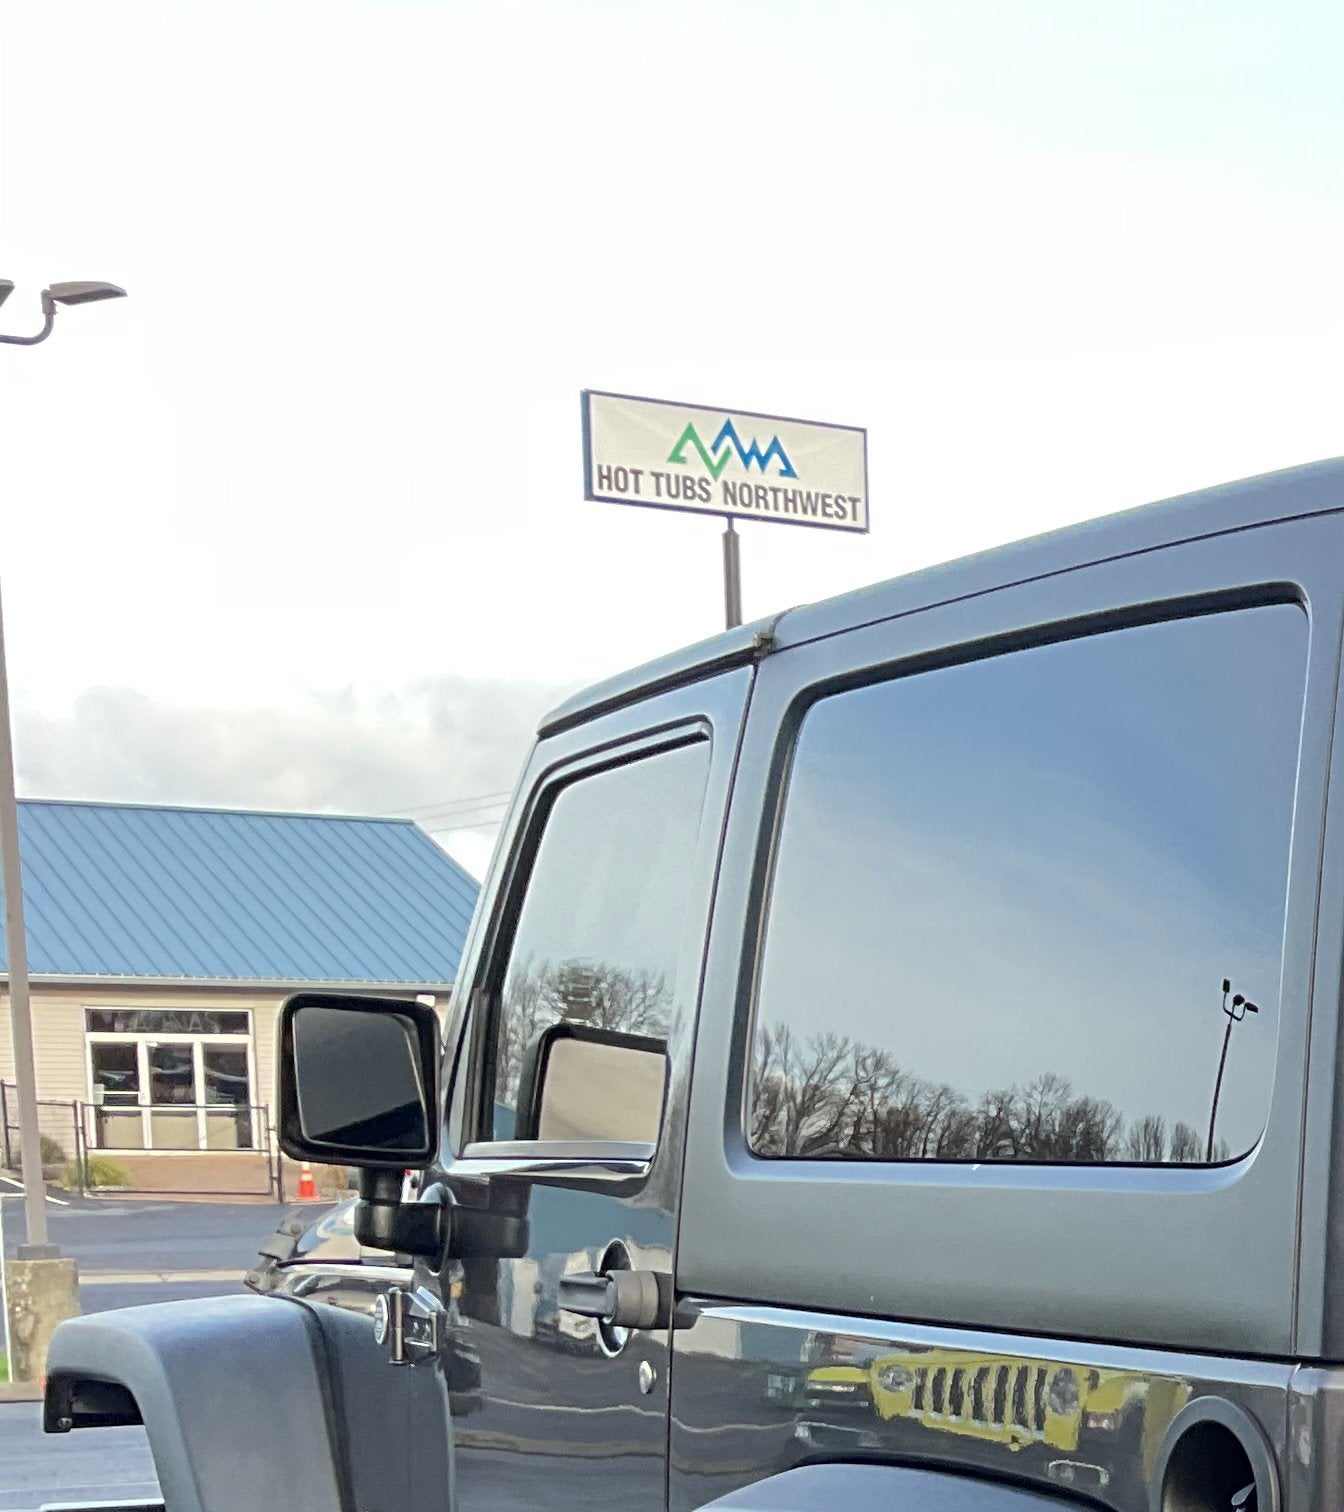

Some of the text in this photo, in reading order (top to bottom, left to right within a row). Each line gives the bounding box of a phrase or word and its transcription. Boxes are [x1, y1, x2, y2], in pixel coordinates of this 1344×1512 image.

[596, 463, 862, 522] HOT TUBS NORTHWEST
